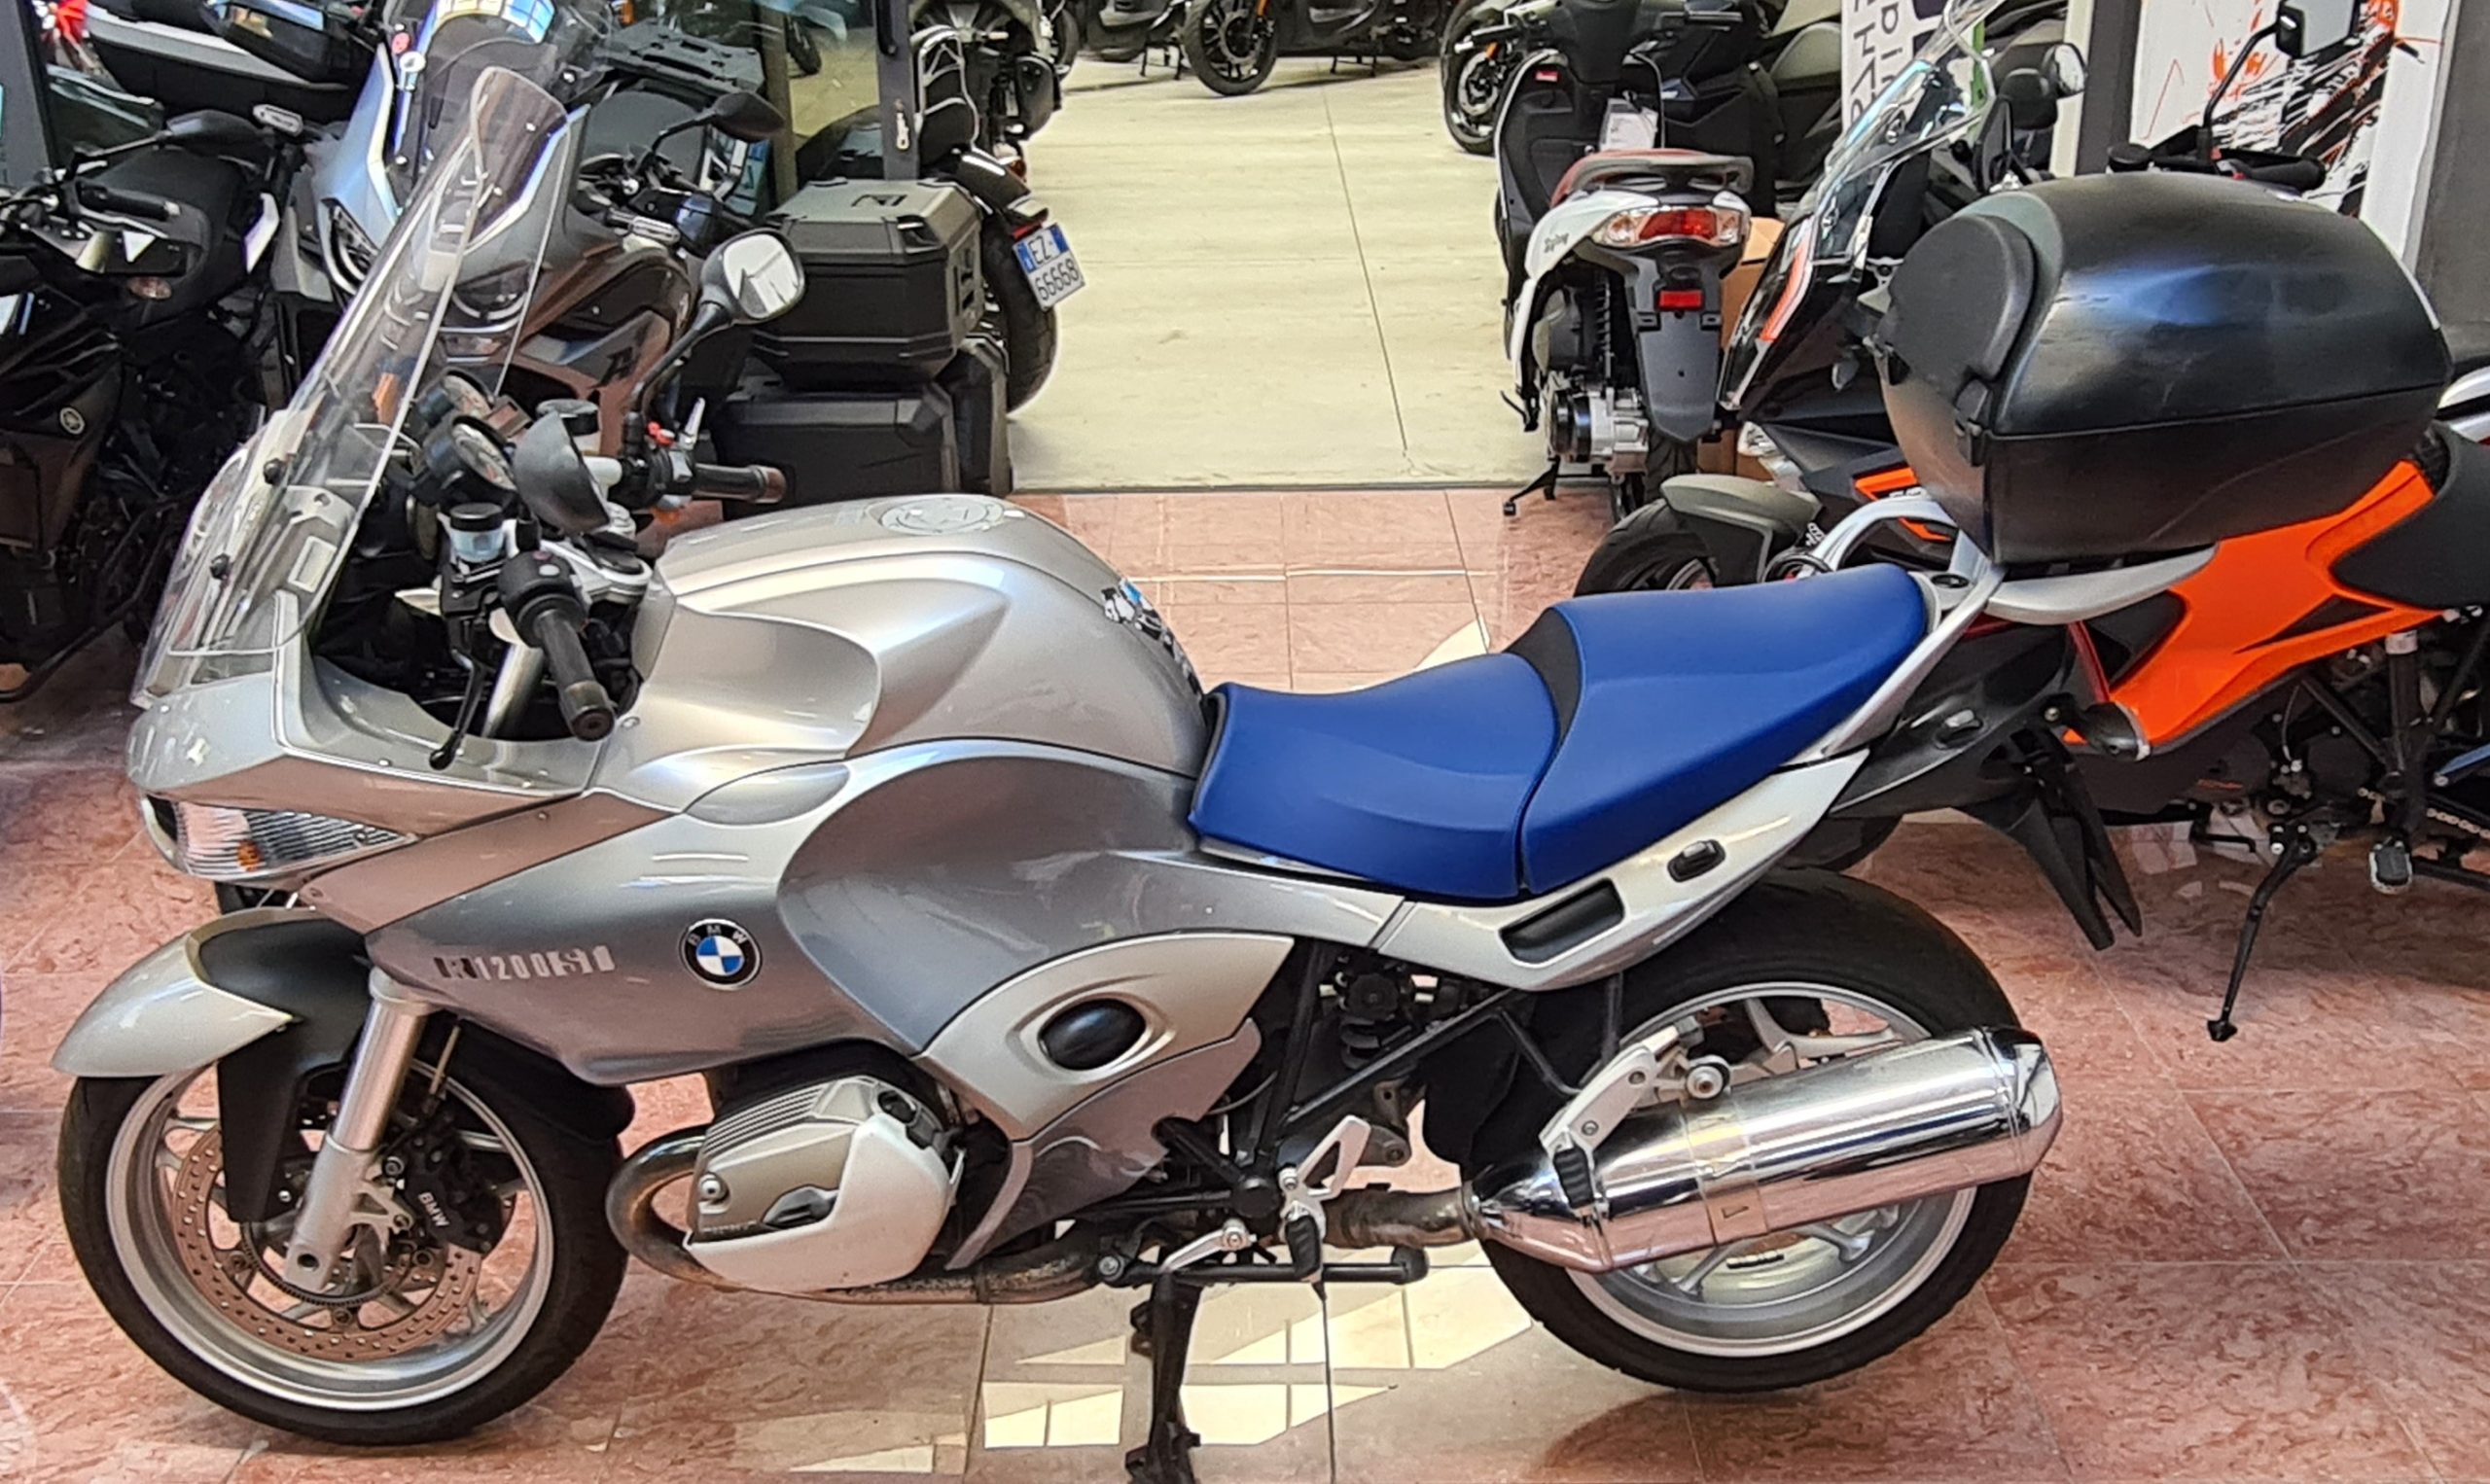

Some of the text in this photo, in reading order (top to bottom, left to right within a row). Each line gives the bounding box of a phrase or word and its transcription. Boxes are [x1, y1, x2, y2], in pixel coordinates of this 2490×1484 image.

[1027, 234, 1051, 265] EZ
[1034, 258, 1080, 300] 66668
[687, 924, 749, 947] BMW
[418, 1192, 450, 1226] BMW
